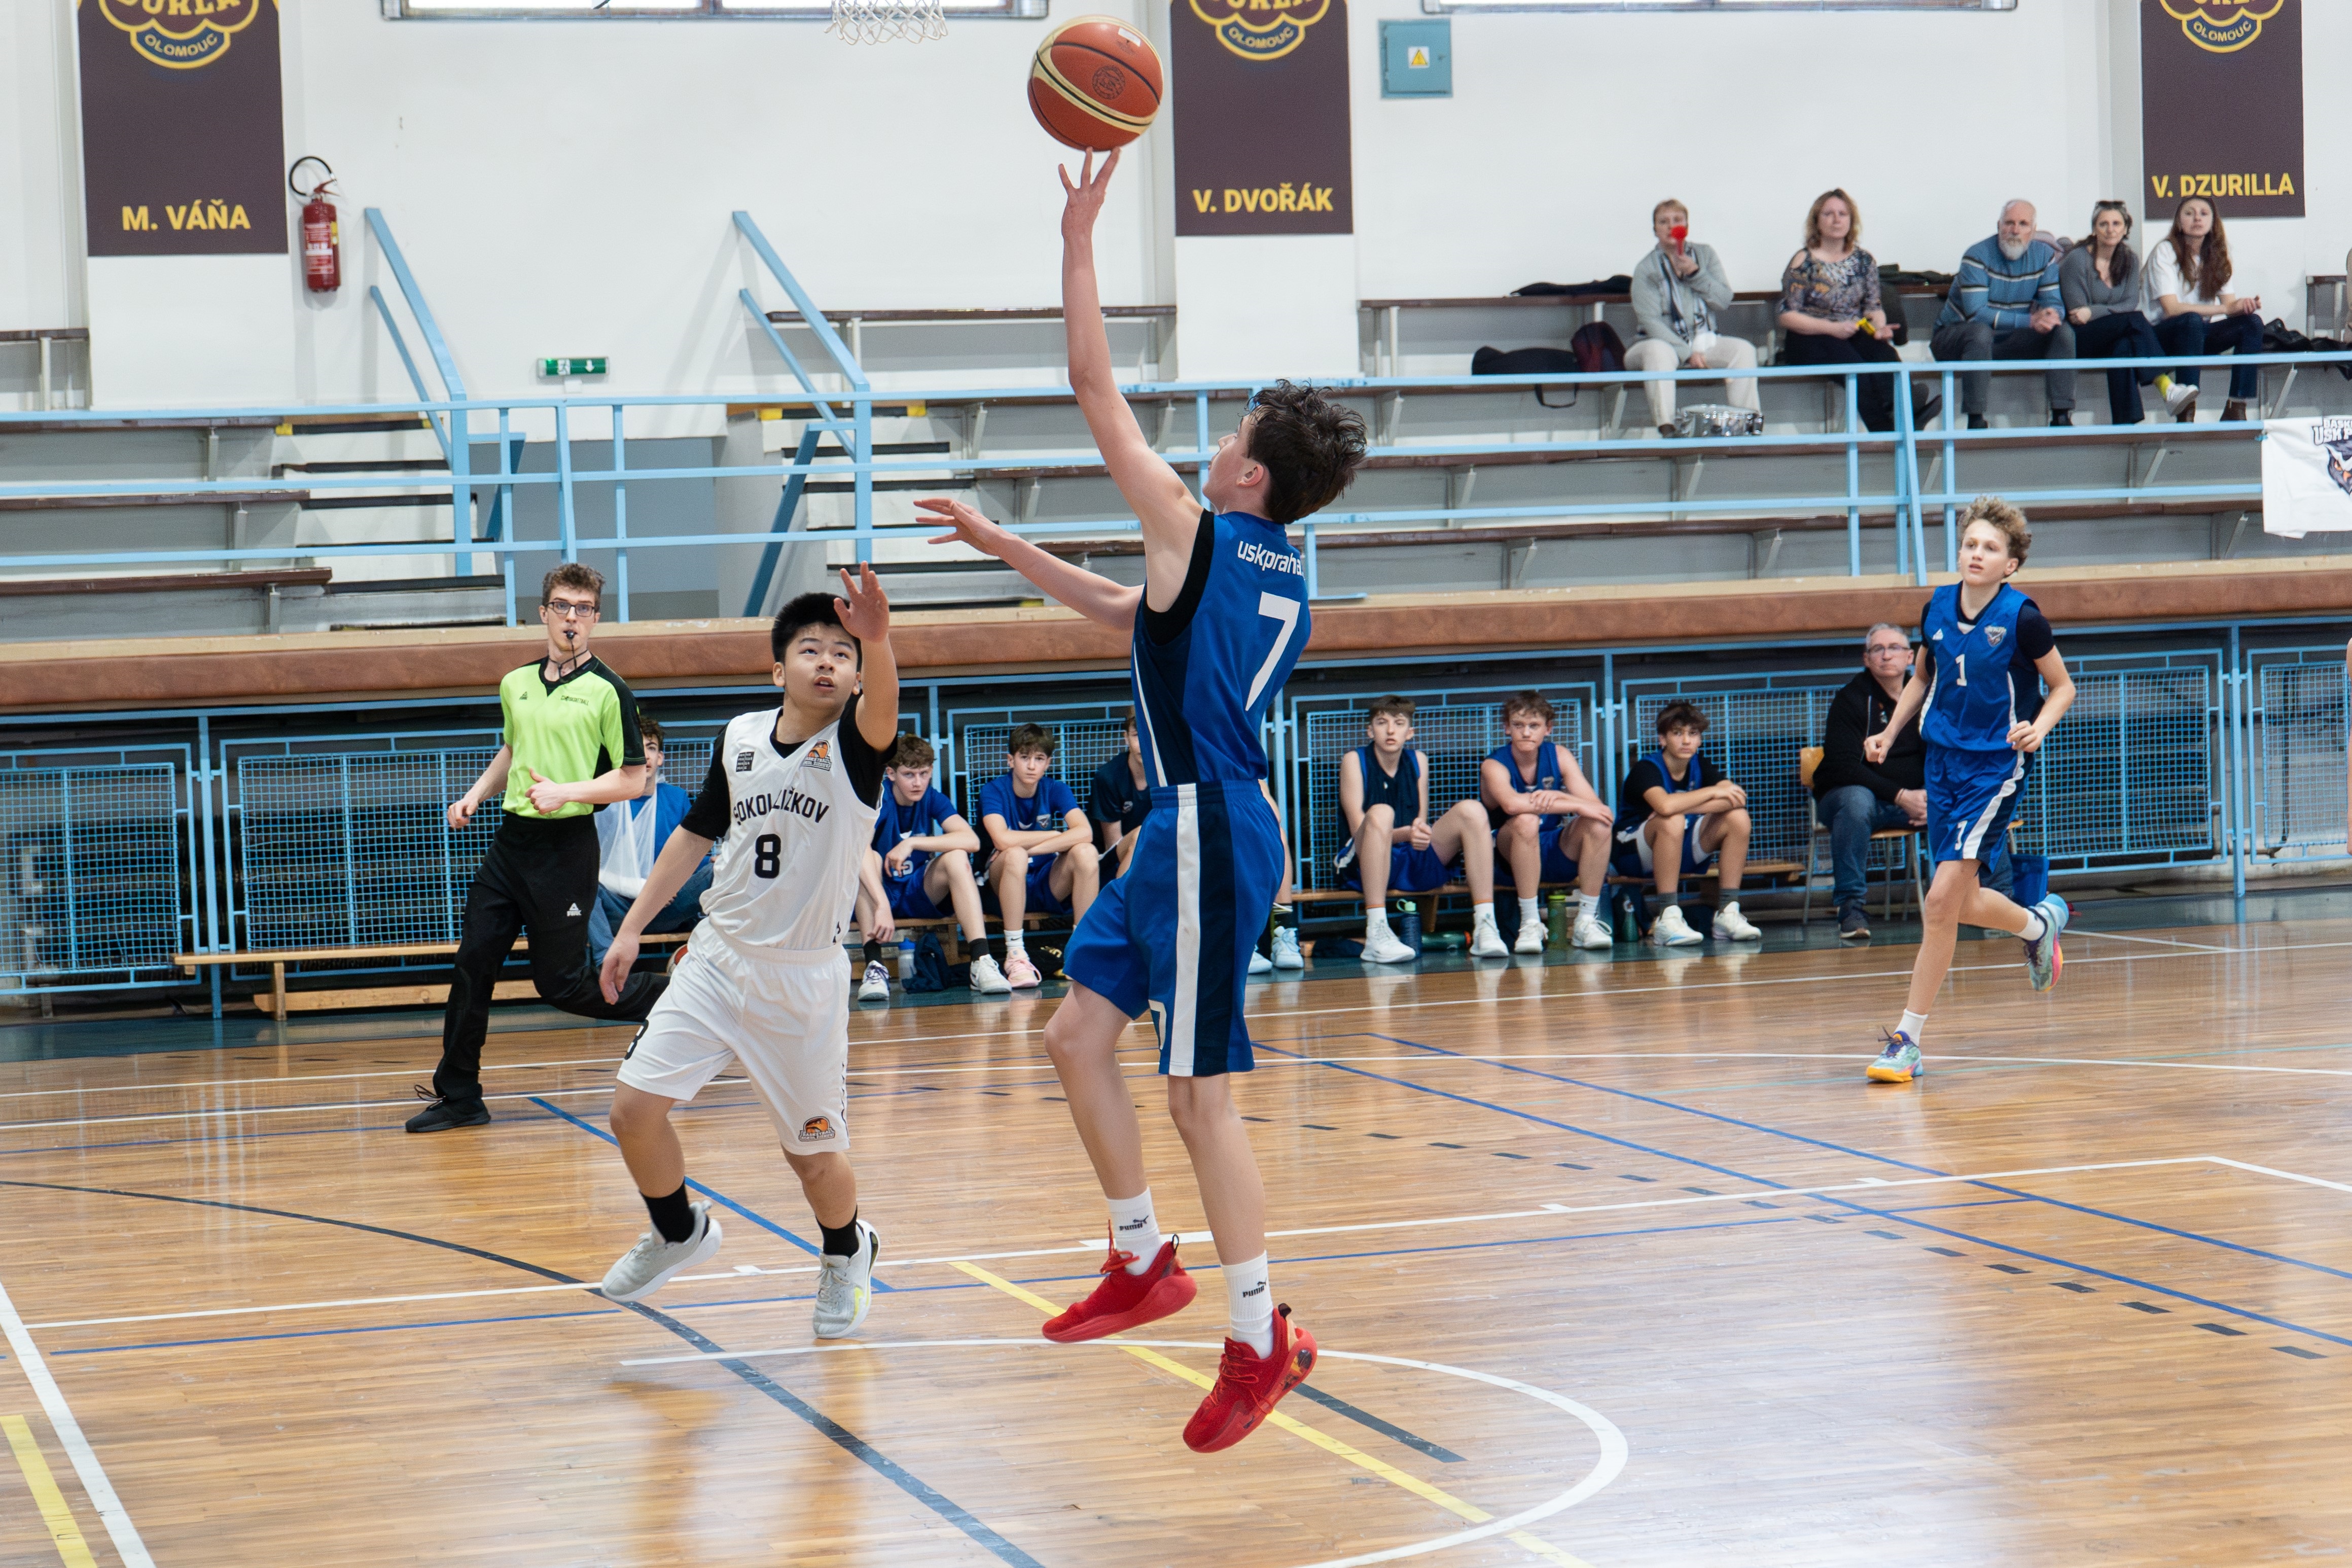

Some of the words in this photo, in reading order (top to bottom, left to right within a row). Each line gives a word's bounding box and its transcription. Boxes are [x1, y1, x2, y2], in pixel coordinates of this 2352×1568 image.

[144, 33, 218, 57] OLOMOUC
[1228, 27, 1294, 48] OLOMOUC
[2193, 21, 2252, 42] OLOMOUC
[1192, 189, 1217, 213] V.
[1224, 182, 1334, 212] DVOŘÁK
[2151, 175, 2173, 198] V.
[2181, 172, 2295, 198] DZURILLA
[122, 205, 158, 231] M.
[165, 199, 252, 230] VÁŇA
[2323, 419, 2352, 429] BASK
[1245, 591, 1301, 711] 7
[1955, 653, 1967, 687] 1
[755, 833, 781, 879] 8
